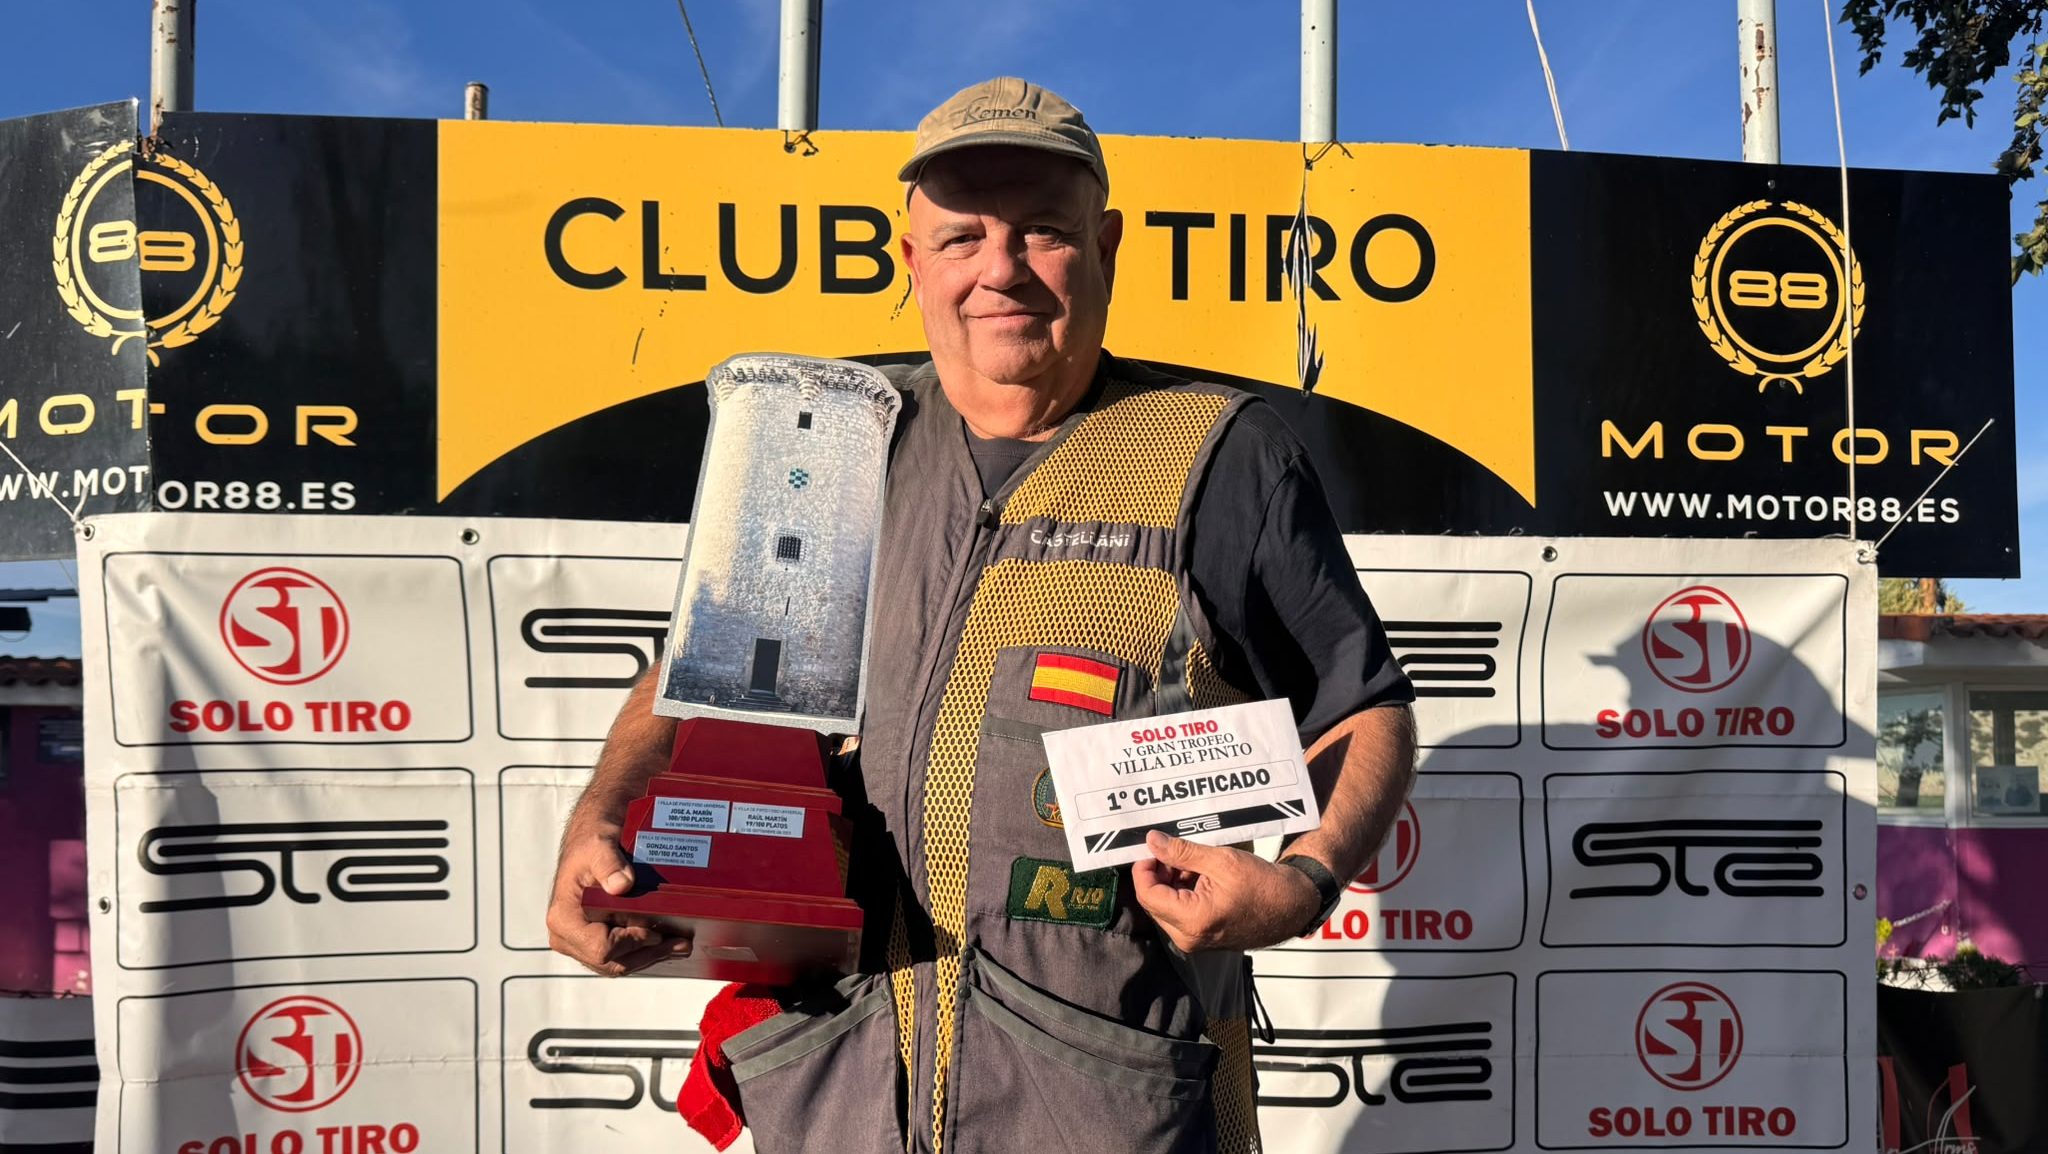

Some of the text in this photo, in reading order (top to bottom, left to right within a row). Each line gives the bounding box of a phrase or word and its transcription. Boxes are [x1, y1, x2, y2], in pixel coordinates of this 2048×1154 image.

[963, 96, 1037, 124] Kemen
[88, 219, 196, 272] 88
[544, 197, 895, 294] CLUB
[1146, 211, 1437, 303] TIRO
[1729, 270, 1828, 309] 88
[0, 388, 358, 446] OTOR
[1601, 419, 1960, 466] MOTOR
[1603, 491, 1960, 524] WWW.MOTOR88.ES
[1030, 530, 1131, 548] CASTELLANI
[169, 699, 411, 733] SOLO TIRO
[1131, 719, 1219, 745] SOLO TIRO
[1595, 705, 1795, 740] SOLO TIRO
[1110, 742, 1253, 776] VILLA DE PINTO
[1122, 733, 1235, 759] V GRAN TROFEO
[1133, 768, 1271, 806] CLASIFICADO
[1024, 865, 1069, 919] R
[1380, 909, 1473, 940] TIRO
[316, 1122, 420, 1154] TIRO
[1587, 1105, 1797, 1139] SOLO TIRO
